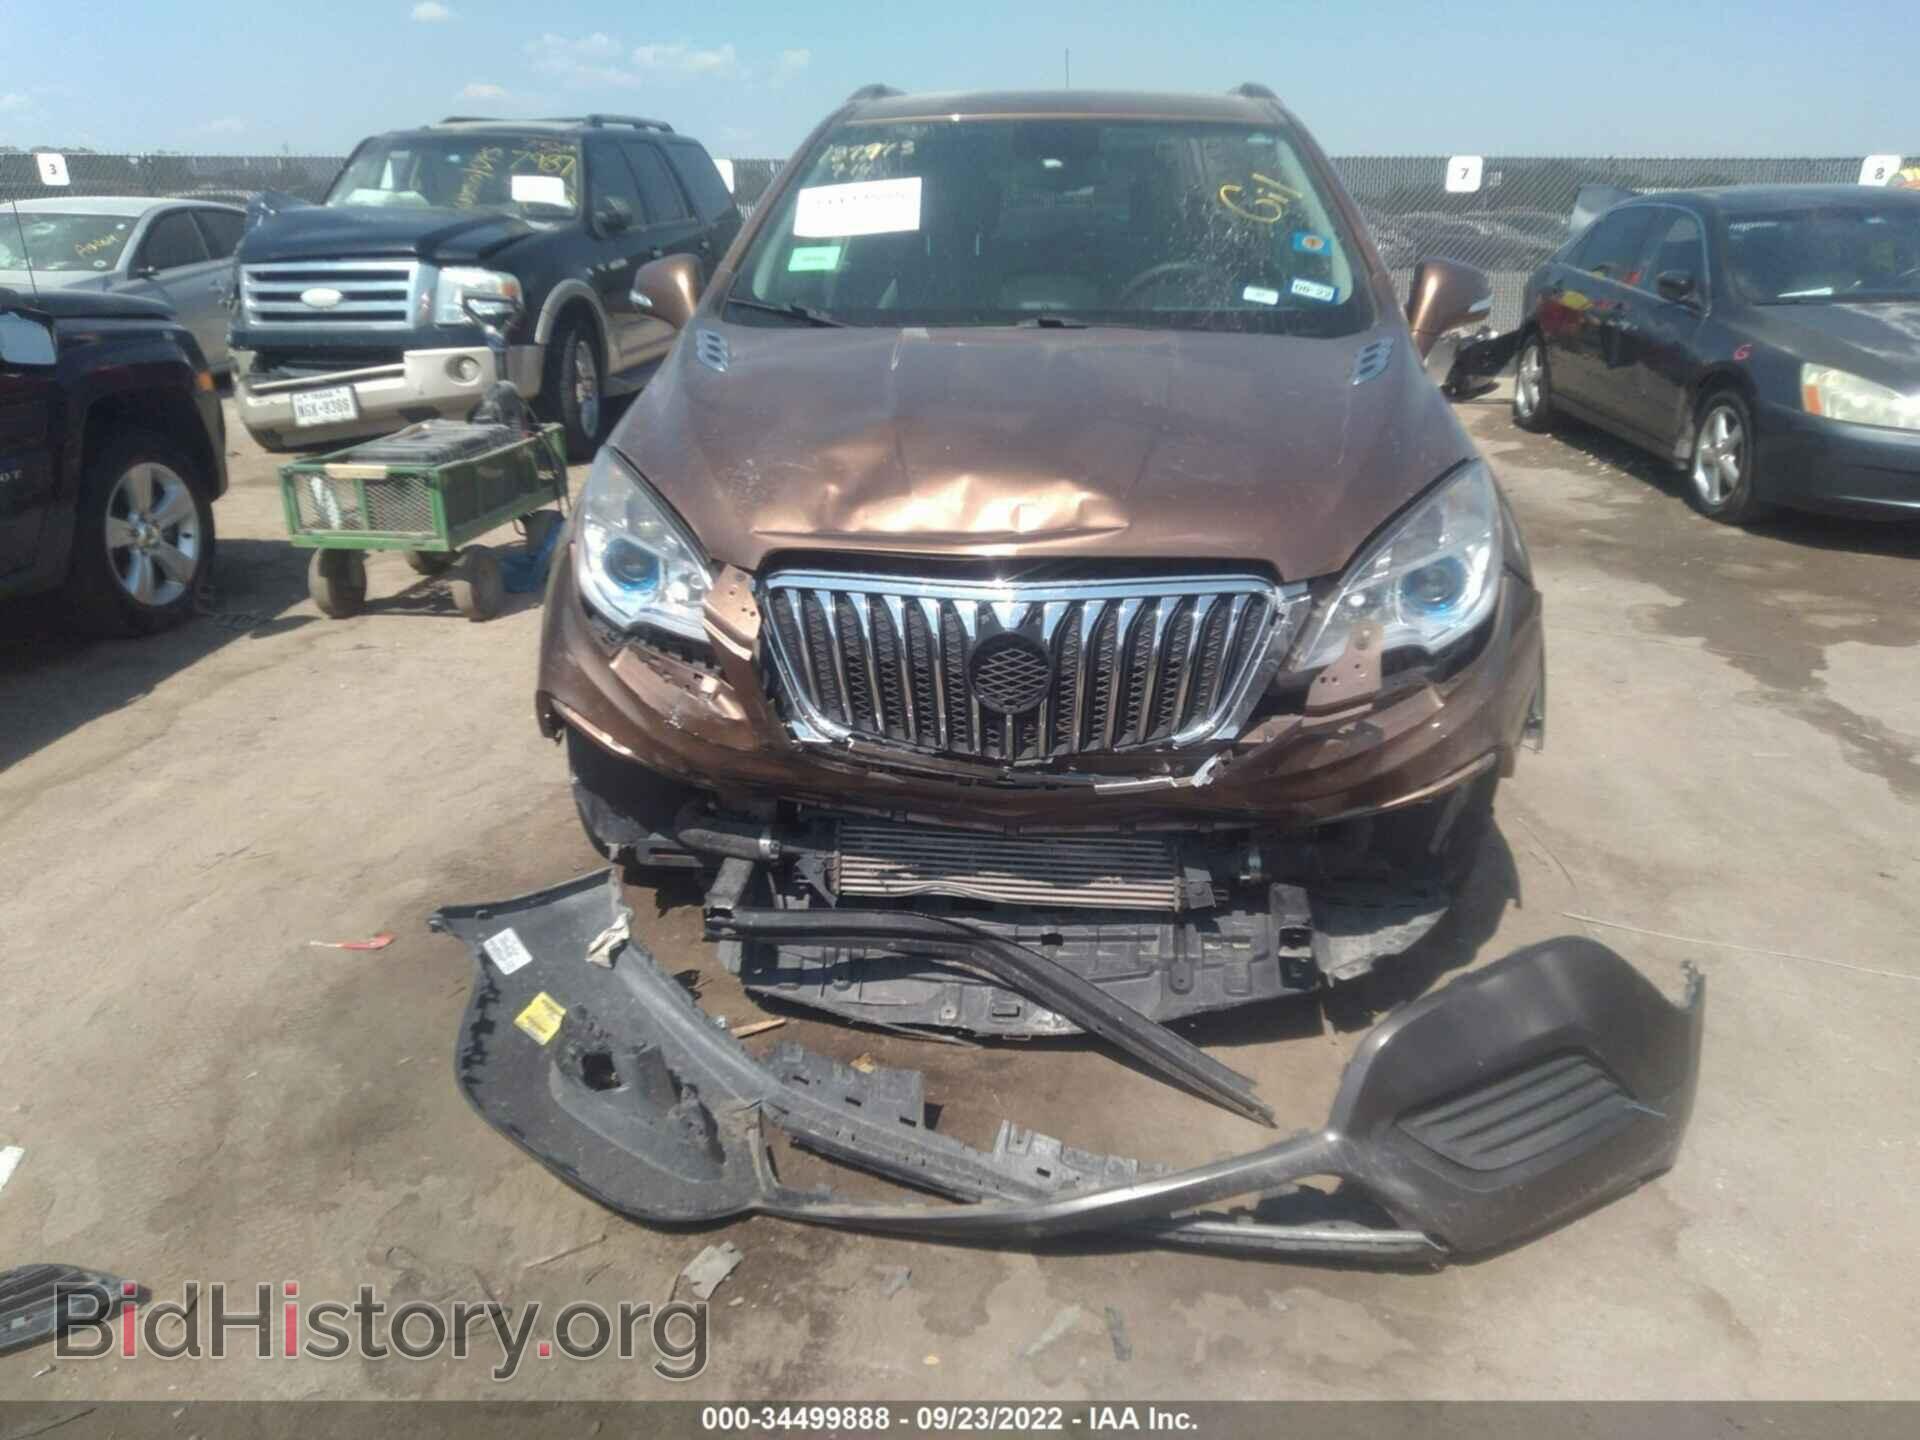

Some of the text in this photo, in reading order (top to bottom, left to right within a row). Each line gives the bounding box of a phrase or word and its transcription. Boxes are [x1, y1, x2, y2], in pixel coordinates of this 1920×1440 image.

[49, 163, 57, 175] 3
[1461, 168, 1470, 180] 7
[1875, 167, 1885, 180] 8
